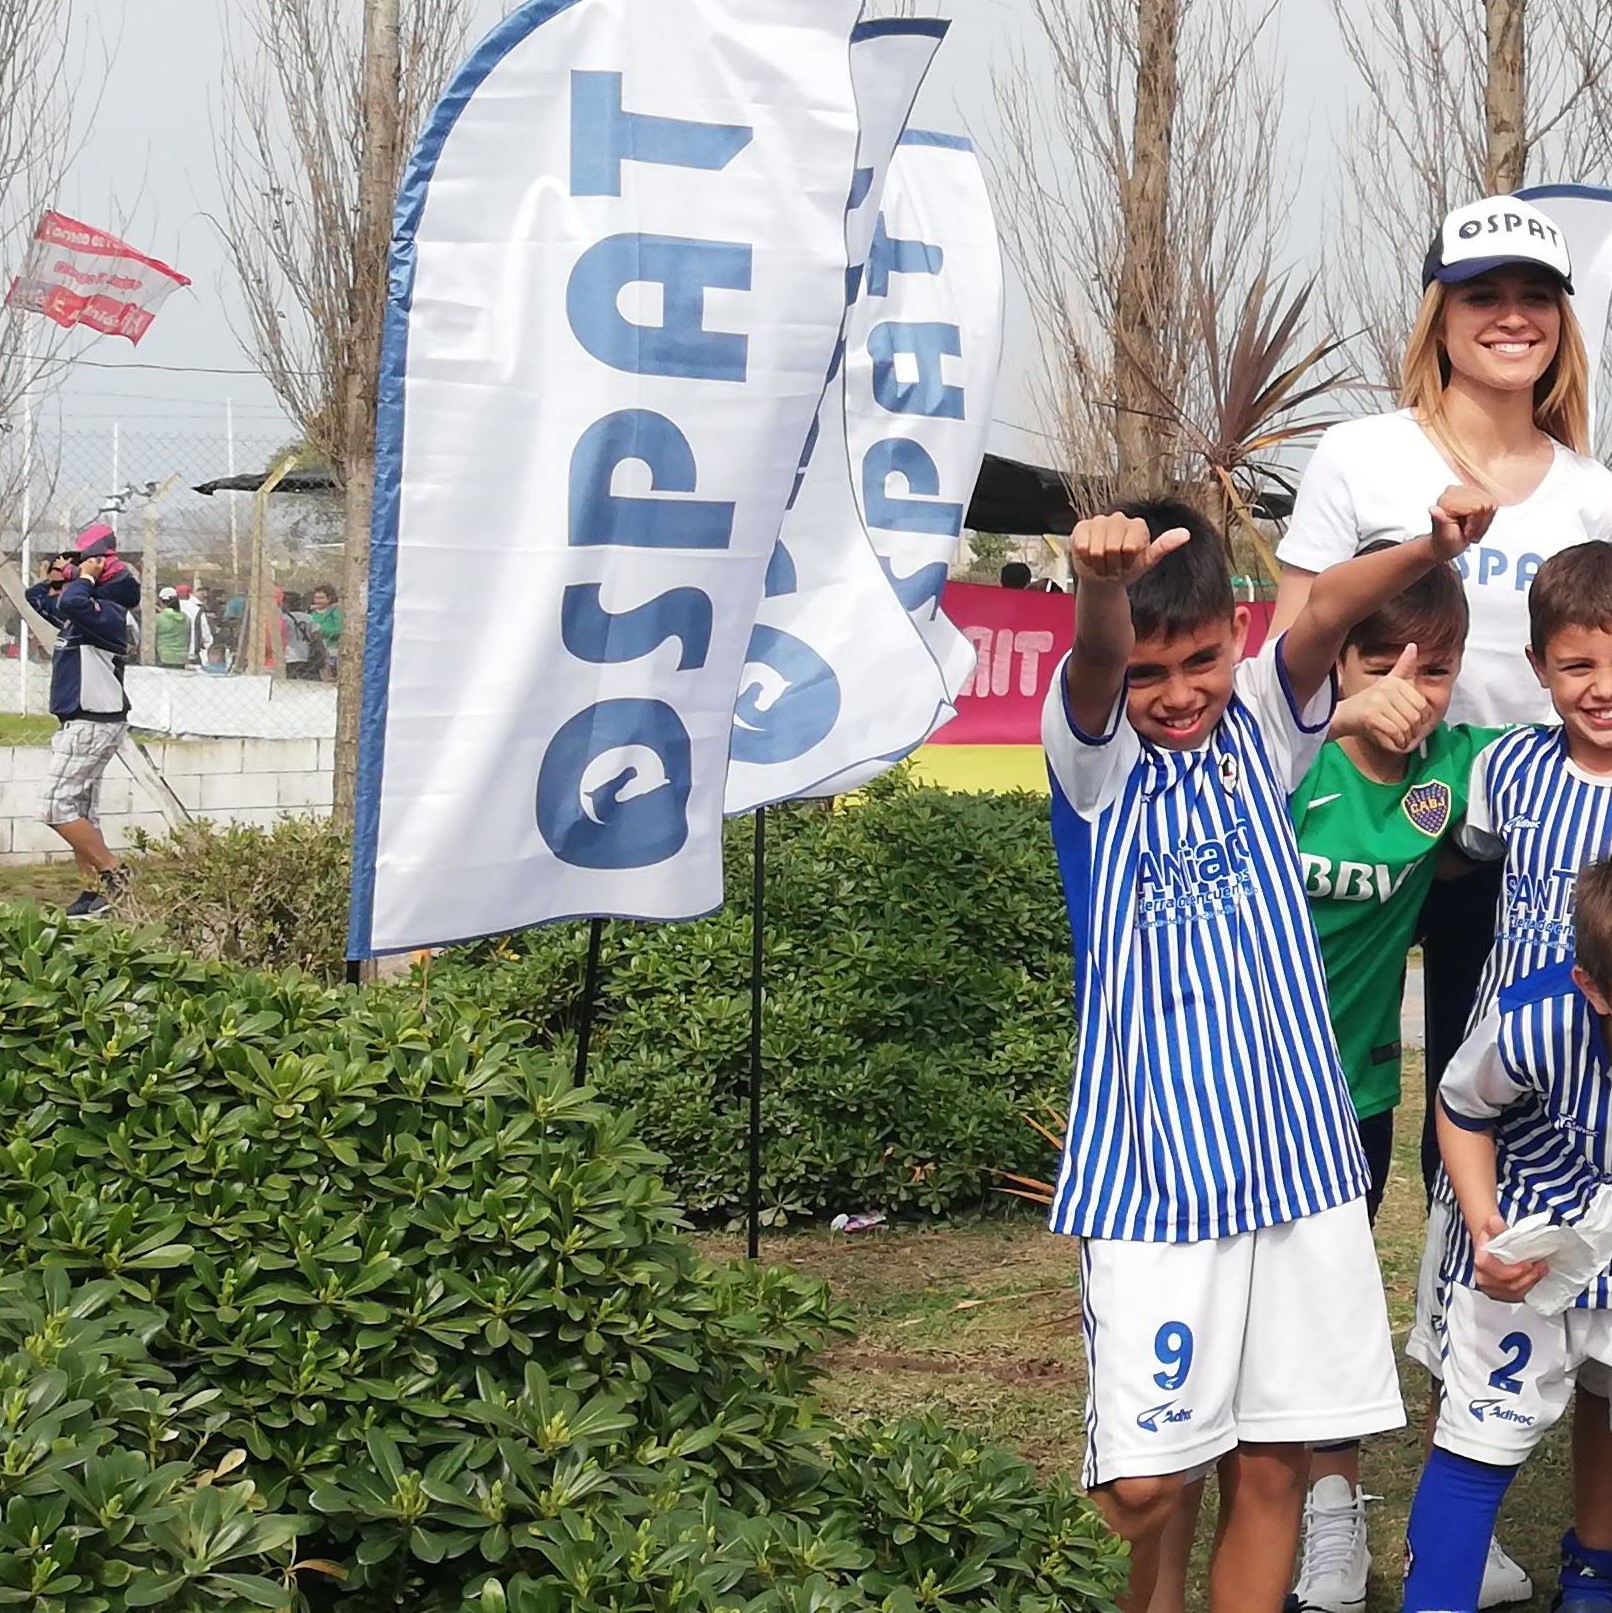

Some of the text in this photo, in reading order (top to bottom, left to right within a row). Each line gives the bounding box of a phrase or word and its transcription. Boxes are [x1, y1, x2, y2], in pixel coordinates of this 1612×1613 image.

[1458, 212, 1559, 248] OSPAT
[536, 69, 754, 870] OSPAT
[1410, 798, 1446, 815] CABJ
[1152, 1320, 1194, 1391] 9
[1488, 1331, 1533, 1396] 2
[1489, 1405, 1536, 1426] Adhoc
